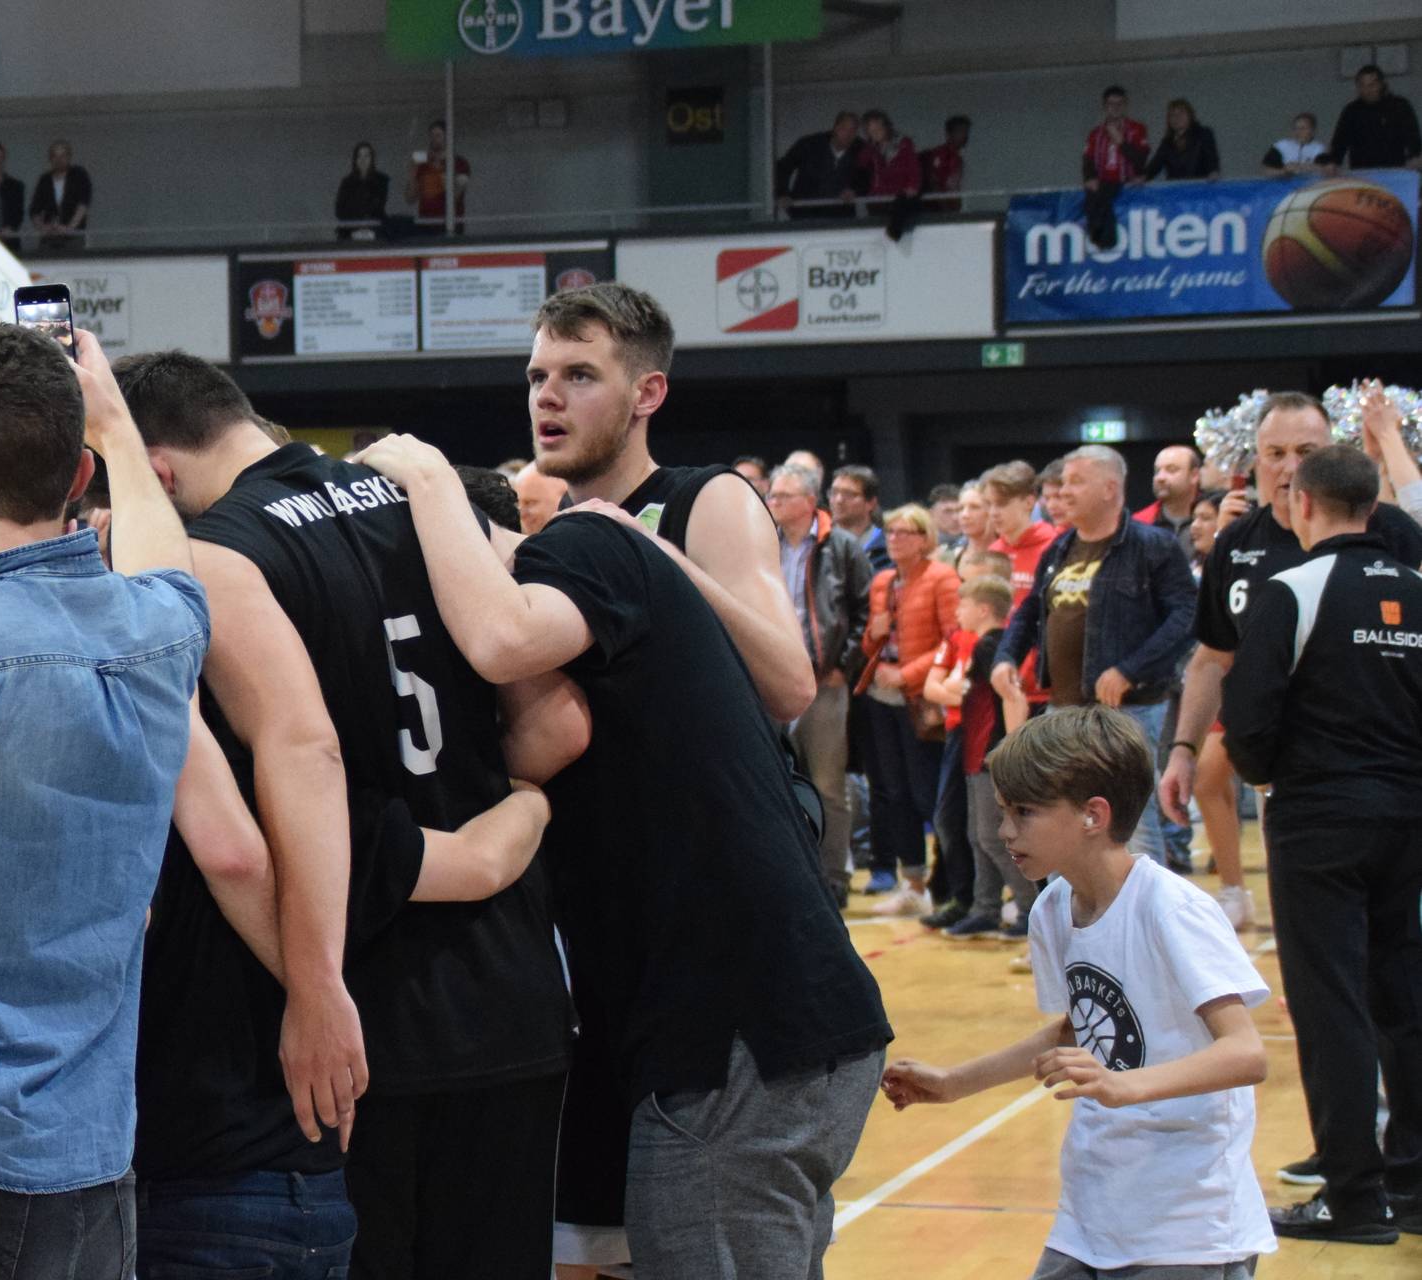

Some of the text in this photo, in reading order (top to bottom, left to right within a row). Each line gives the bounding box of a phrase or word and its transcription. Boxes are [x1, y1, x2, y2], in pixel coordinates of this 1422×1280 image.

[667, 102, 724, 132] Ost
[824, 250, 863, 265] TSV
[807, 267, 880, 292] Bayer
[1017, 265, 1247, 299] For the real game
[73, 297, 125, 317] ayer
[829, 293, 857, 311] 04
[807, 311, 881, 325] Leverkusen
[263, 491, 337, 528] WWU
[1228, 578, 1249, 615] 6
[383, 613, 443, 776] 5
[1074, 974, 1127, 1018] BASKETS
